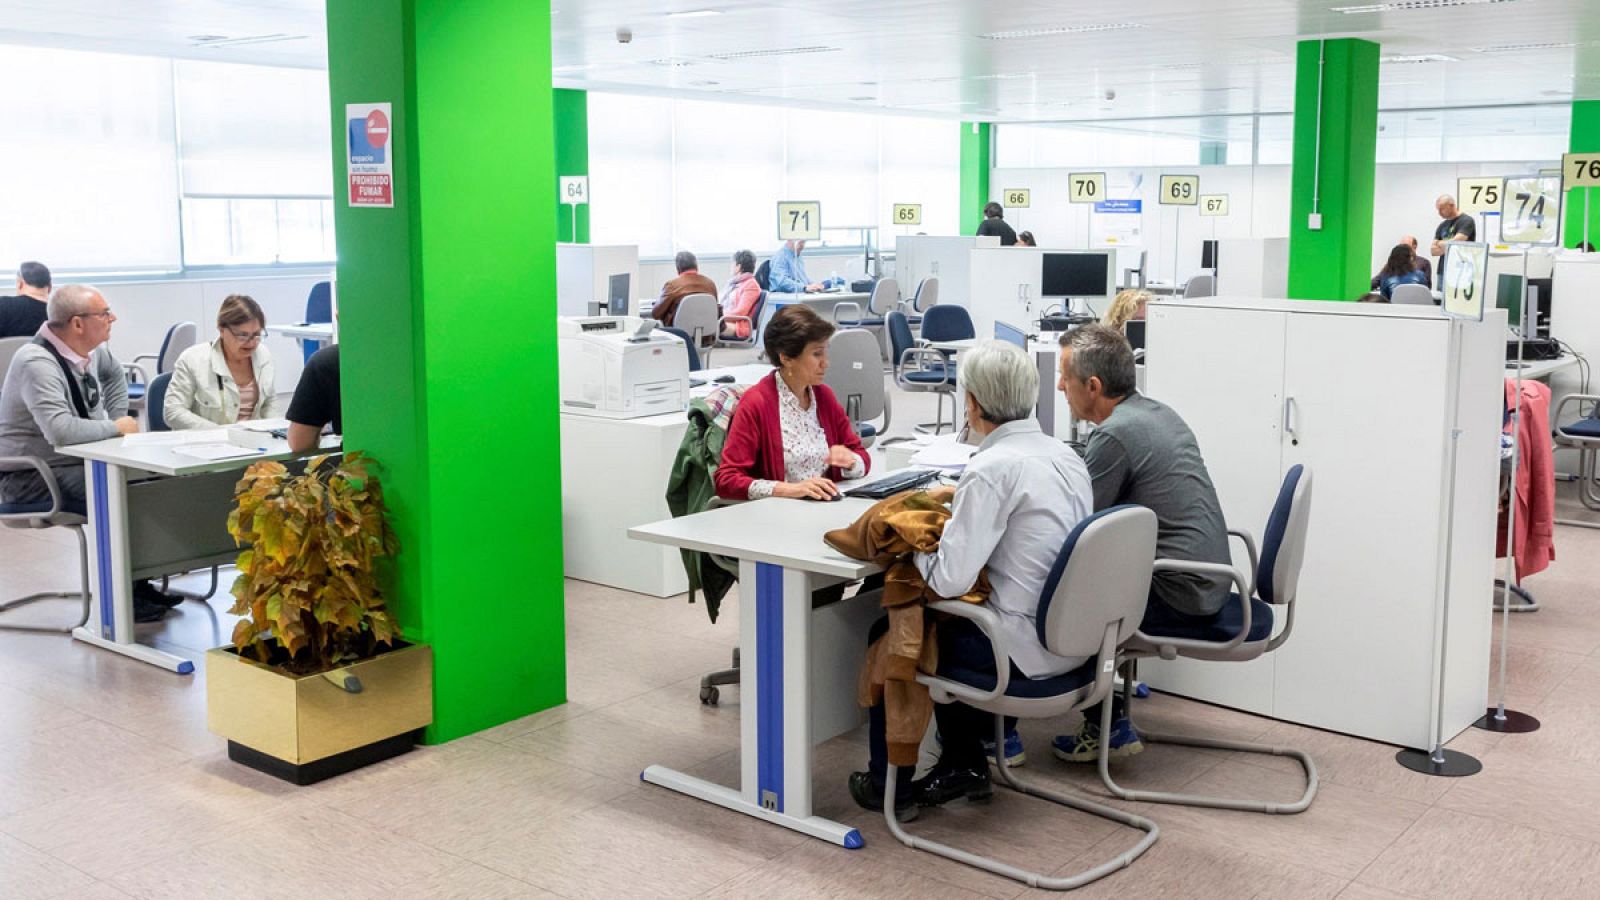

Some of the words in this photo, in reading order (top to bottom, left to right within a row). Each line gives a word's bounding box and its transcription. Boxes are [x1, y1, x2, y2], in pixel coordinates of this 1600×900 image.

[1574, 160, 1600, 179] 76
[352, 175, 389, 185] PROHIBIDO
[360, 186, 383, 196] FUMAR
[567, 182, 583, 197] 64
[1075, 179, 1096, 197] 70
[1171, 182, 1192, 198] 69
[1470, 185, 1498, 205] 75
[1010, 192, 1025, 204] 66
[1207, 199, 1223, 211] 67
[899, 208, 915, 221] 65
[1515, 192, 1546, 229] 74
[788, 209, 809, 232] 71
